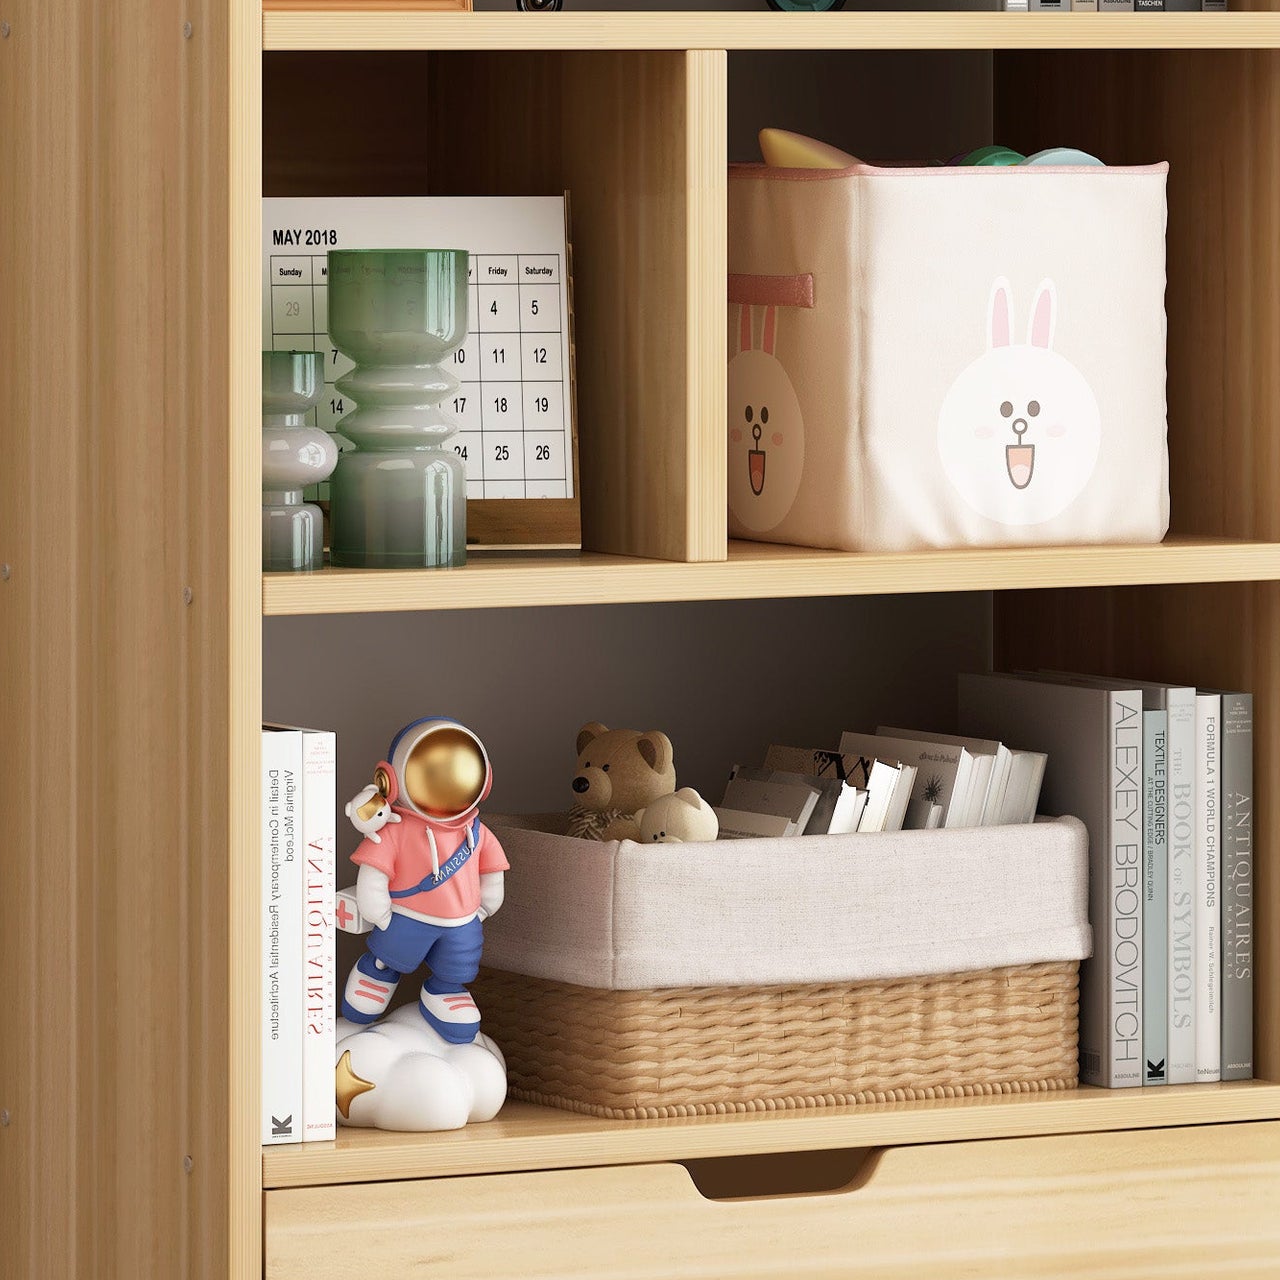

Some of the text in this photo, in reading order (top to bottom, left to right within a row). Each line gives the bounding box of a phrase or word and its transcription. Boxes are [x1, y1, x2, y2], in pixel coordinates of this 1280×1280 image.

[273, 229, 338, 246] MAY 2018
[279, 268, 302, 277] Sunday
[488, 267, 507, 276] Friday
[525, 266, 553, 276] Saturday
[286, 302, 300, 316] 29
[490, 300, 497, 315] 4
[531, 300, 538, 315] 5
[331, 350, 338, 364] 7
[454, 349, 465, 363] 10
[492, 349, 505, 363] 11
[533, 348, 547, 363] 12
[330, 399, 343, 414] 14
[453, 398, 466, 413] 17
[494, 398, 507, 412] 18
[535, 397, 549, 412] 19
[495, 445, 509, 461] 25
[536, 445, 550, 460] 26
[1206, 717, 1215, 775] FORMULA
[1147, 776, 1153, 784] AT
[1155, 730, 1165, 845] TEXTILE DESIGNERS
[1206, 788, 1215, 833] WORLD
[1173, 784, 1191, 859] BOOK
[1206, 838, 1215, 907] CHAMPIONS
[1115, 701, 1138, 1061] ALEXEY BRODOVITCH
[1232, 792, 1251, 980] ANTIQUAIRES
[1173, 892, 1191, 1029] SYMBOLS
